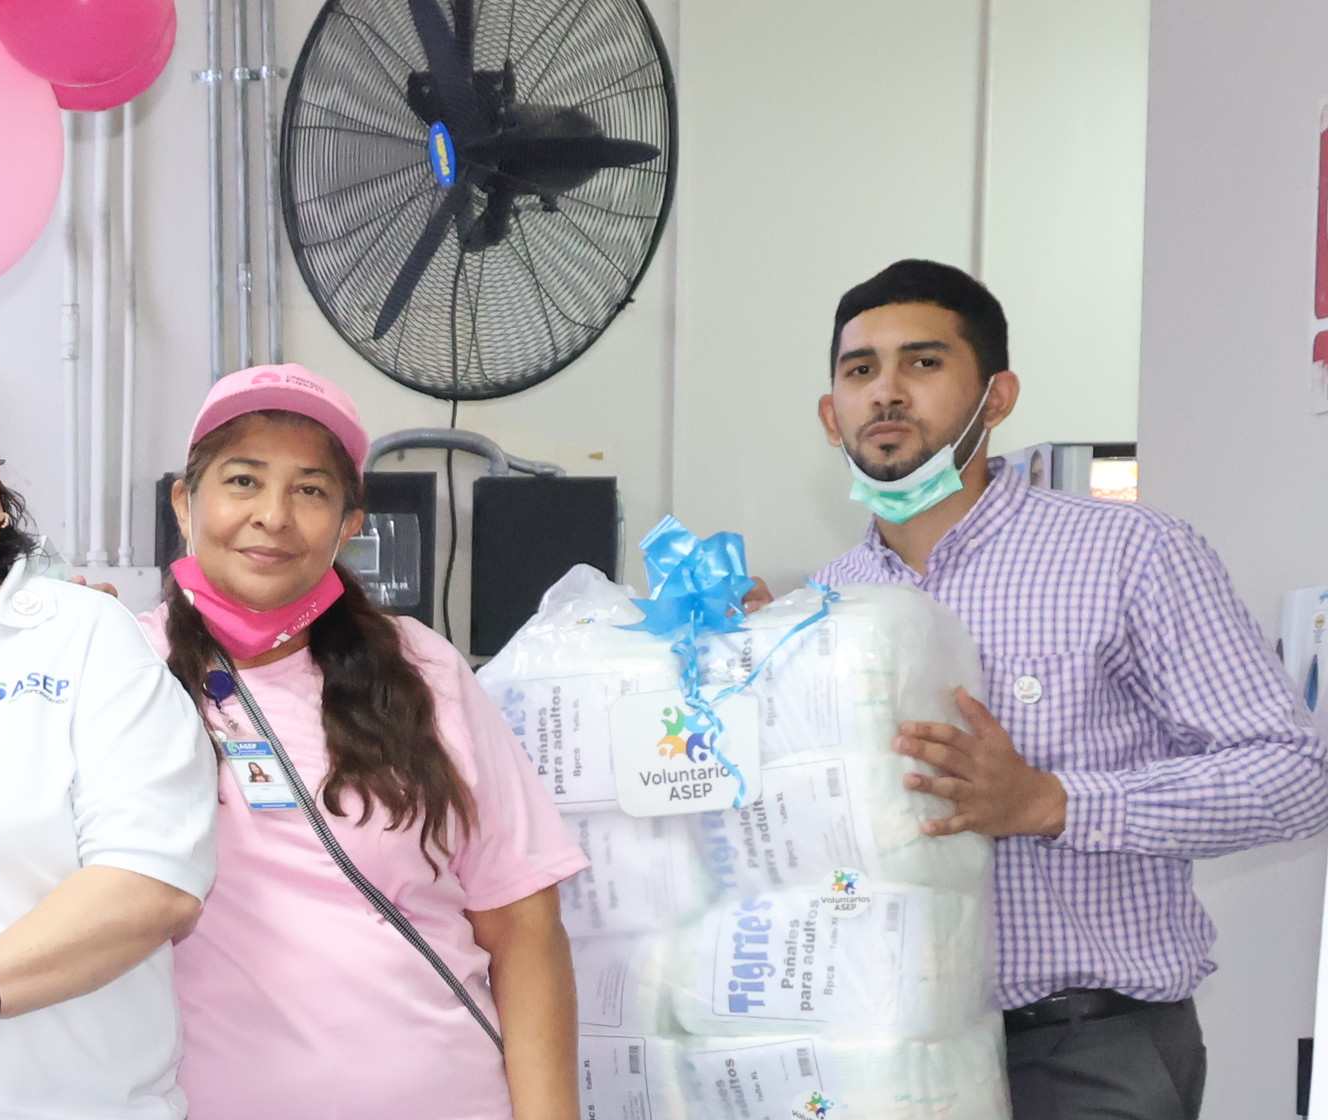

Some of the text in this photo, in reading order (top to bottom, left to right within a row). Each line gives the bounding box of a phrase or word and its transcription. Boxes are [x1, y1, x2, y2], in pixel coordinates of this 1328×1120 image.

[11, 672, 70, 697] ASEP
[537, 707, 549, 776] Pañales
[550, 685, 566, 795] para adultos
[640, 764, 739, 787] Voluntario
[669, 783, 713, 801] ASEP
[820, 896, 872, 905] Voluntarios
[834, 903, 857, 912] ASEP
[781, 919, 801, 990] Pañales
[800, 899, 820, 1012] para adultos
